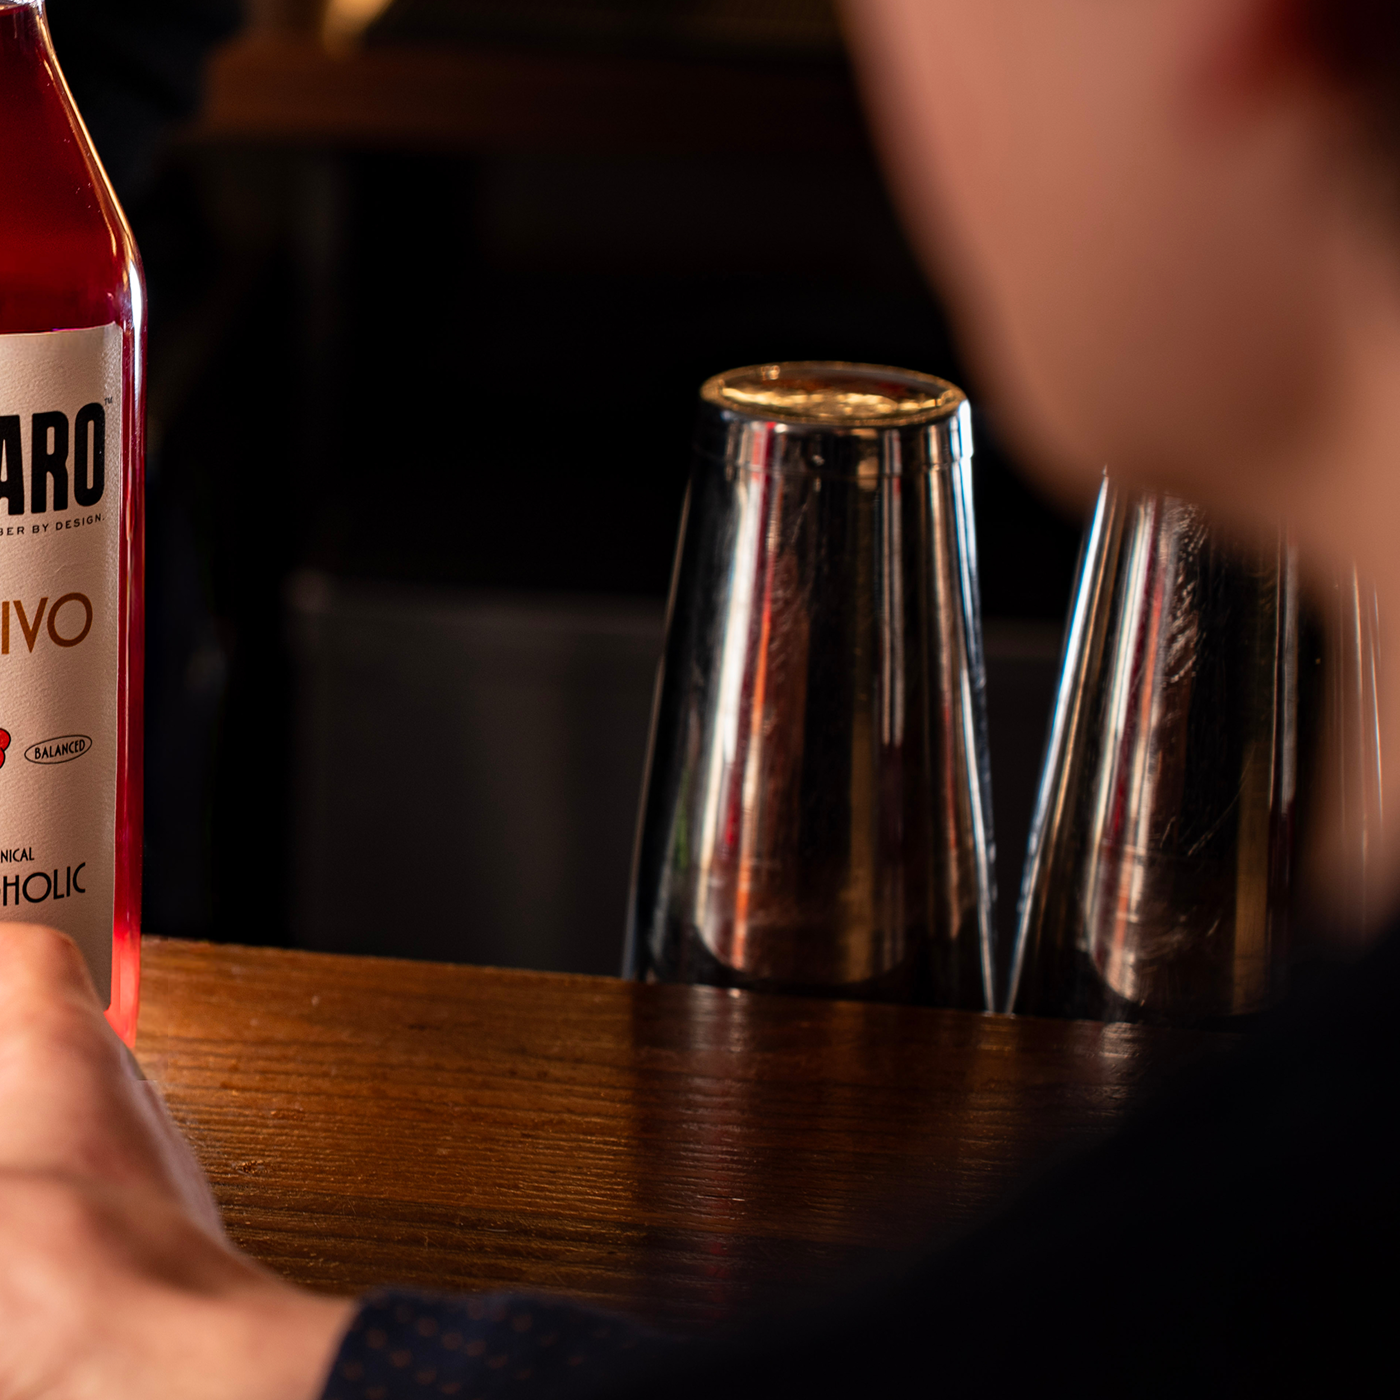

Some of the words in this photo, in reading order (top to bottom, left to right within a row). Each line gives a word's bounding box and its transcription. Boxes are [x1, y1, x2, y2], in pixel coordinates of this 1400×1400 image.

[32, 522, 49, 534] BY
[55, 513, 106, 531] DESIGN.
[34, 739, 86, 760] BALANCED
